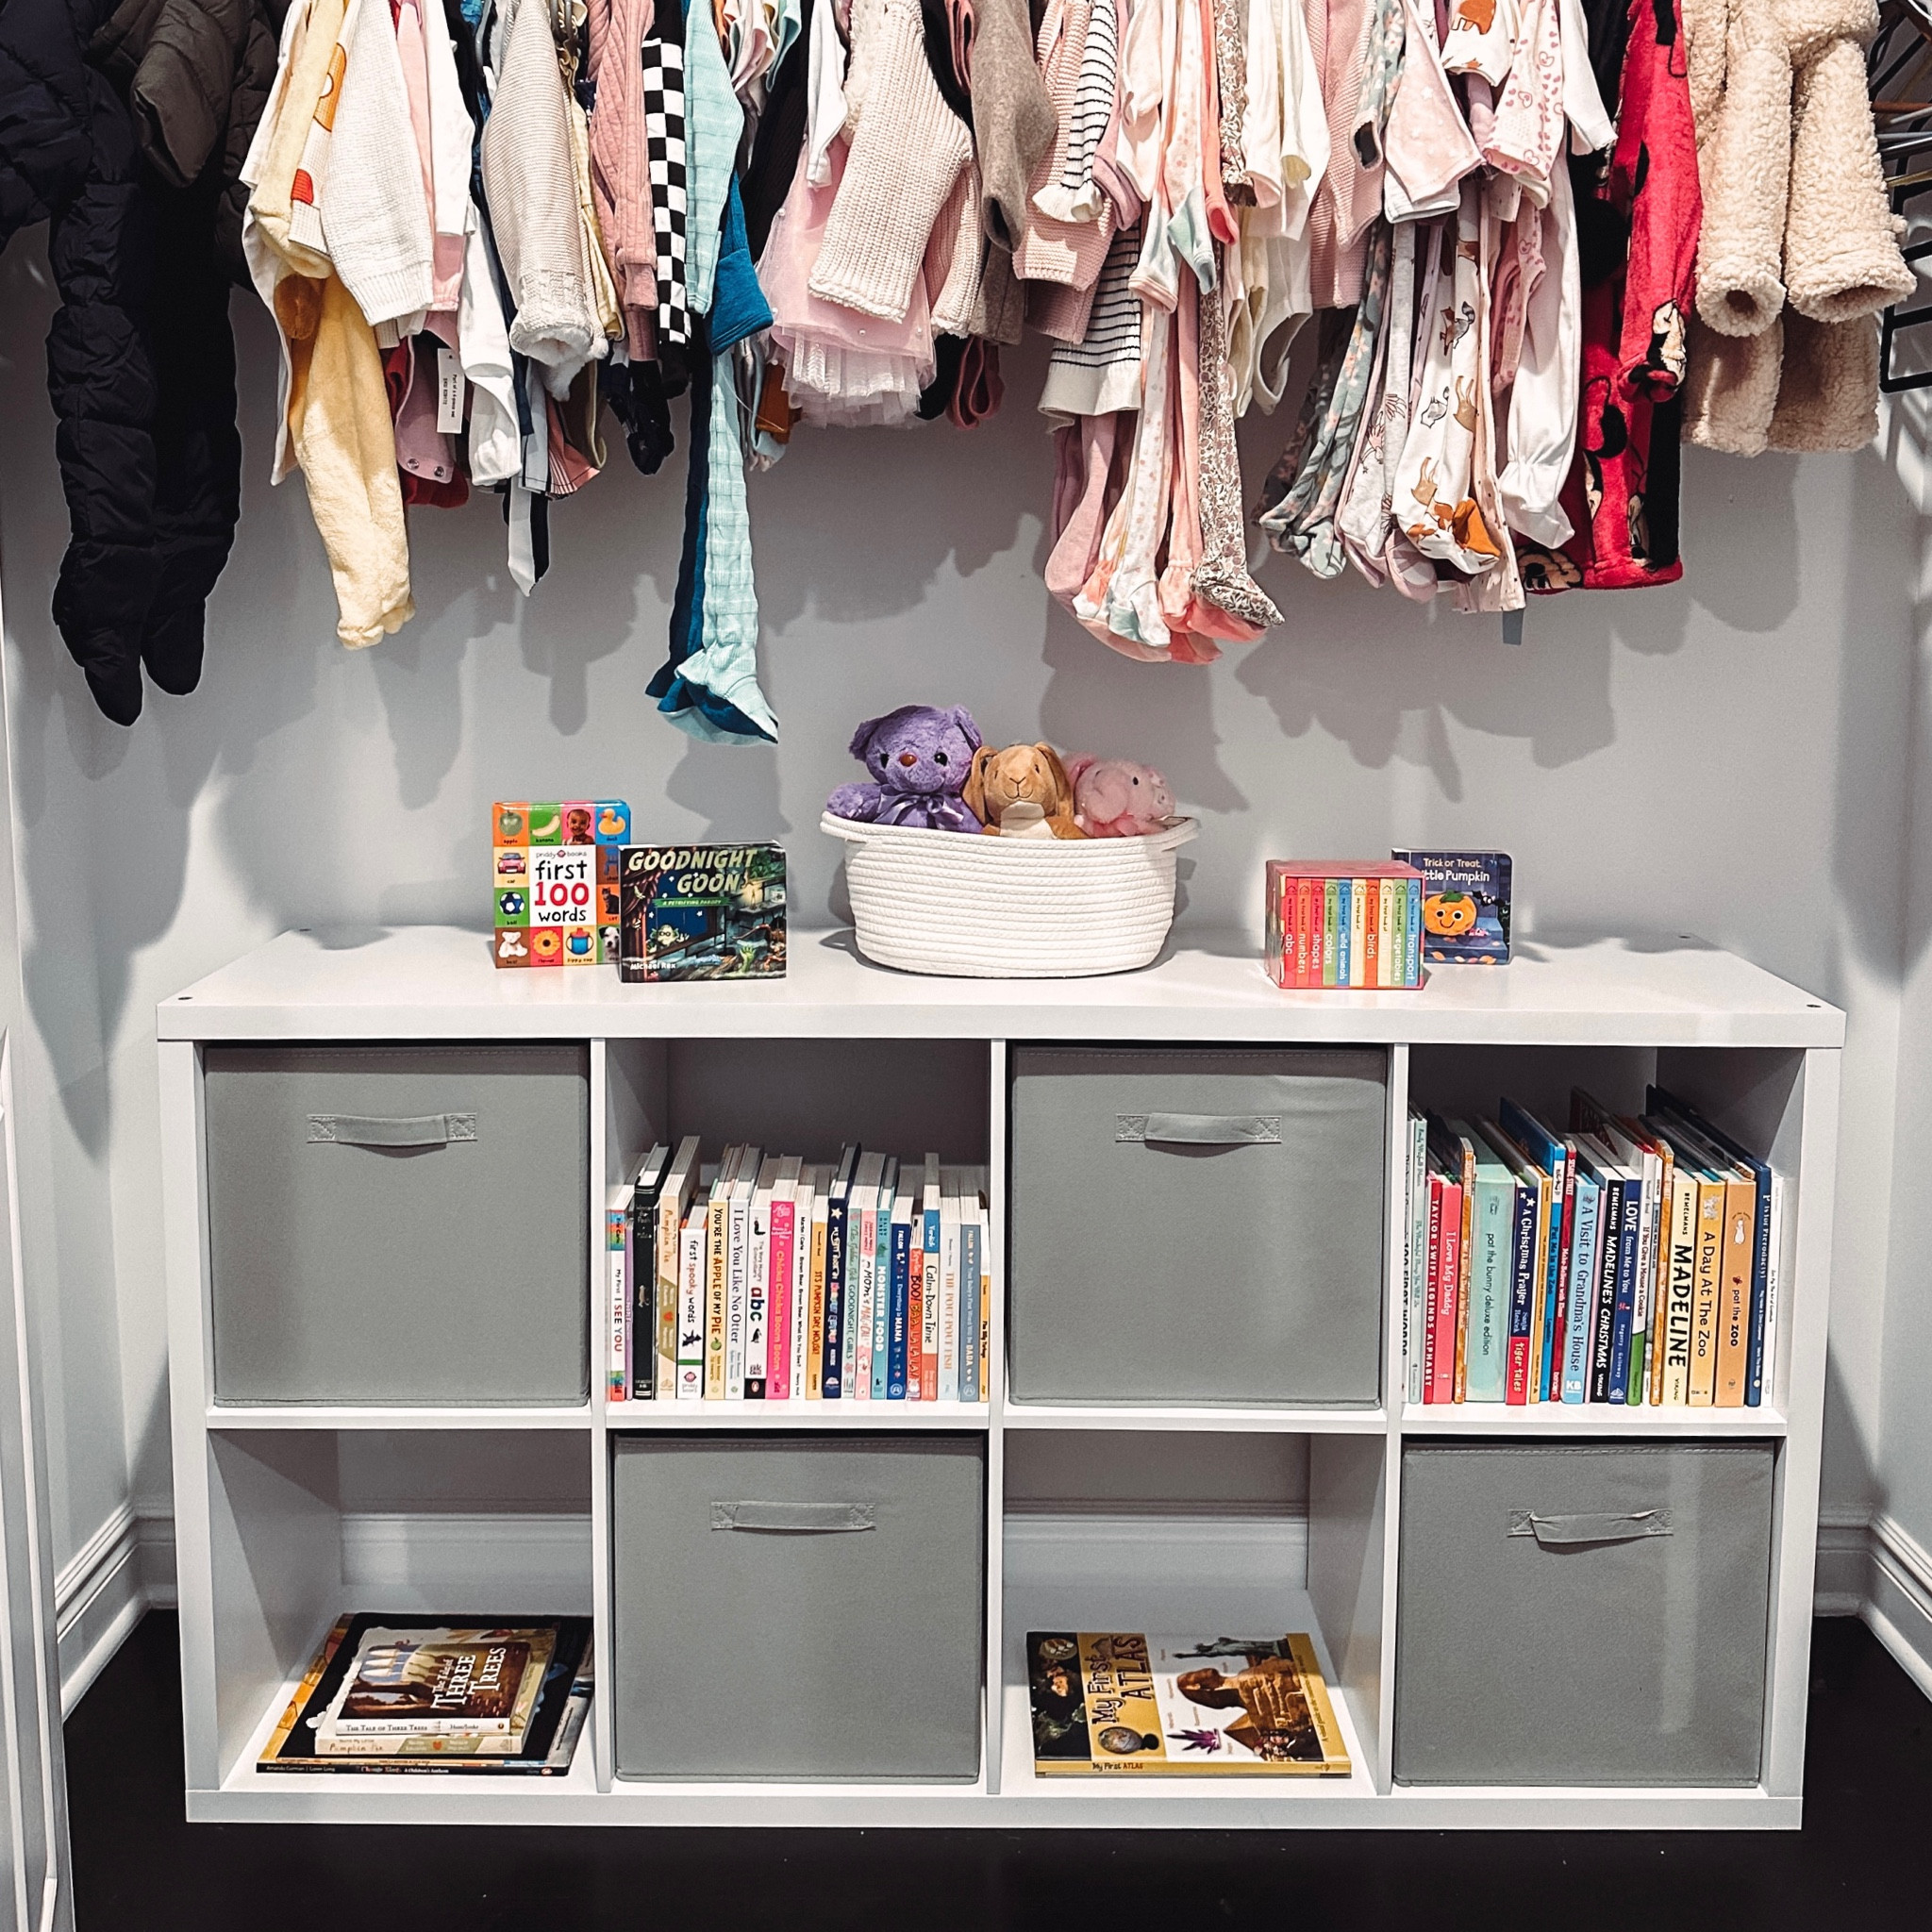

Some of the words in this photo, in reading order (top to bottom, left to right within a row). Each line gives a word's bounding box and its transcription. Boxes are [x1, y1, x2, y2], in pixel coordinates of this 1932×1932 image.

[535, 859, 588, 880] first
[628, 849, 758, 872] GOODNIGHT
[1423, 858, 1444, 867] Trick
[676, 873, 741, 893] GOON
[1445, 870, 1491, 886] Pumpkin
[534, 881, 590, 907] 100
[538, 907, 587, 923] words
[1285, 933, 1295, 955] abc
[1297, 933, 1308, 974] numbers
[1310, 933, 1323, 970] shapes
[1324, 933, 1336, 965] colors
[1367, 933, 1377, 959] birds
[1393, 933, 1403, 981] vegetables
[1406, 933, 1416, 980] transport
[1339, 950, 1348, 980] animals
[1567, 1158, 1576, 1177] SESAME
[1566, 1178, 1574, 1196] STREET
[1430, 1199, 1440, 1240] TAYLOR
[1581, 1207, 1593, 1215] A
[1609, 1187, 1620, 1231] BEMELMANS
[1624, 1200, 1639, 1232] LOVE
[1682, 1192, 1690, 1236] BEMELMANS
[714, 1208, 724, 1238] YOU'RE
[733, 1217, 744, 1242] Love
[1551, 1226, 1559, 1239] Put
[1580, 1219, 1594, 1248] Visit
[713, 1240, 722, 1256] THE
[1486, 1233, 1495, 1248] pat
[1518, 1217, 1533, 1270] Christmas
[1550, 1240, 1557, 1254] Me
[1624, 1236, 1635, 1256] from
[1641, 1232, 1650, 1245] You
[1704, 1231, 1716, 1242] A
[689, 1240, 699, 1261] first
[732, 1245, 743, 1266] You
[1429, 1244, 1438, 1276] SWIFT
[1445, 1238, 1457, 1263] Love
[1487, 1249, 1497, 1263] the
[1578, 1252, 1591, 1265] to
[1623, 1256, 1633, 1269] Me
[1641, 1246, 1649, 1261] Give
[1699, 1245, 1716, 1274] Day
[615, 1269, 622, 1278] My
[685, 1262, 698, 1295] spooky
[712, 1257, 723, 1290] APPLE
[776, 1250, 785, 1282] Chicka
[1441, 1264, 1455, 1282] My
[1601, 1235, 1618, 1305] MADELINE'S
[1623, 1269, 1630, 1277] to
[1639, 1267, 1648, 1288] Mouse
[731, 1269, 743, 1293] Like
[876, 1265, 887, 1318] MONSTER
[910, 1274, 922, 1302] BOO!
[924, 1265, 938, 1320] Calm-Down
[945, 1273, 955, 1288] THE
[1483, 1266, 1496, 1293] bunny
[1516, 1271, 1530, 1306] Prayer
[1621, 1277, 1631, 1293] You
[1700, 1277, 1713, 1296] At
[712, 1303, 721, 1315] MY
[713, 1291, 722, 1301] OF
[731, 1295, 742, 1311] No
[750, 1287, 765, 1323] abc
[774, 1282, 784, 1314] Chicka
[813, 1284, 823, 1314] PUMPKIN
[846, 1284, 857, 1334] GOODNIGHT,
[1427, 1281, 1436, 1329] LEGENDS
[1441, 1284, 1455, 1316] Daddy
[1573, 1270, 1590, 1332] Grandma's
[1637, 1294, 1646, 1318] Cookie
[1667, 1243, 1693, 1368] MADELINE
[1732, 1289, 1740, 1305] pat
[614, 1305, 623, 1324] SEE
[688, 1297, 696, 1324] words
[1483, 1295, 1494, 1324] deluxe
[1520, 1311, 1529, 1331] Sanja
[1699, 1299, 1712, 1326] The
[1732, 1307, 1741, 1322] the
[614, 1327, 623, 1352] YOU
[730, 1313, 742, 1343] Otter
[774, 1315, 783, 1342] Boom
[875, 1321, 885, 1352] FOOD
[909, 1330, 921, 1345] LA
[924, 1322, 936, 1343] Time
[1482, 1325, 1493, 1356] edition
[1595, 1308, 1611, 1369] CHRISTMAS
[909, 1345, 920, 1358] LA
[1514, 1341, 1525, 1367] tiger
[1570, 1336, 1585, 1372] House
[1697, 1329, 1710, 1357] Zoo
[773, 1343, 782, 1371] Boom
[908, 1359, 920, 1377] LA!
[943, 1349, 953, 1370] FISH
[1424, 1333, 1434, 1387] ALPHABET
[1513, 1368, 1524, 1393] tales
[1566, 1379, 1582, 1390] KB
[1596, 1373, 1605, 1397] VIKING
[467, 1647, 508, 1695] TREES
[1084, 1654, 1115, 1694] First
[1112, 1635, 1155, 1700] ATLAS
[430, 1654, 477, 1708] THREE
[1091, 1697, 1126, 1724] My
[1092, 1762, 1104, 1772] My
